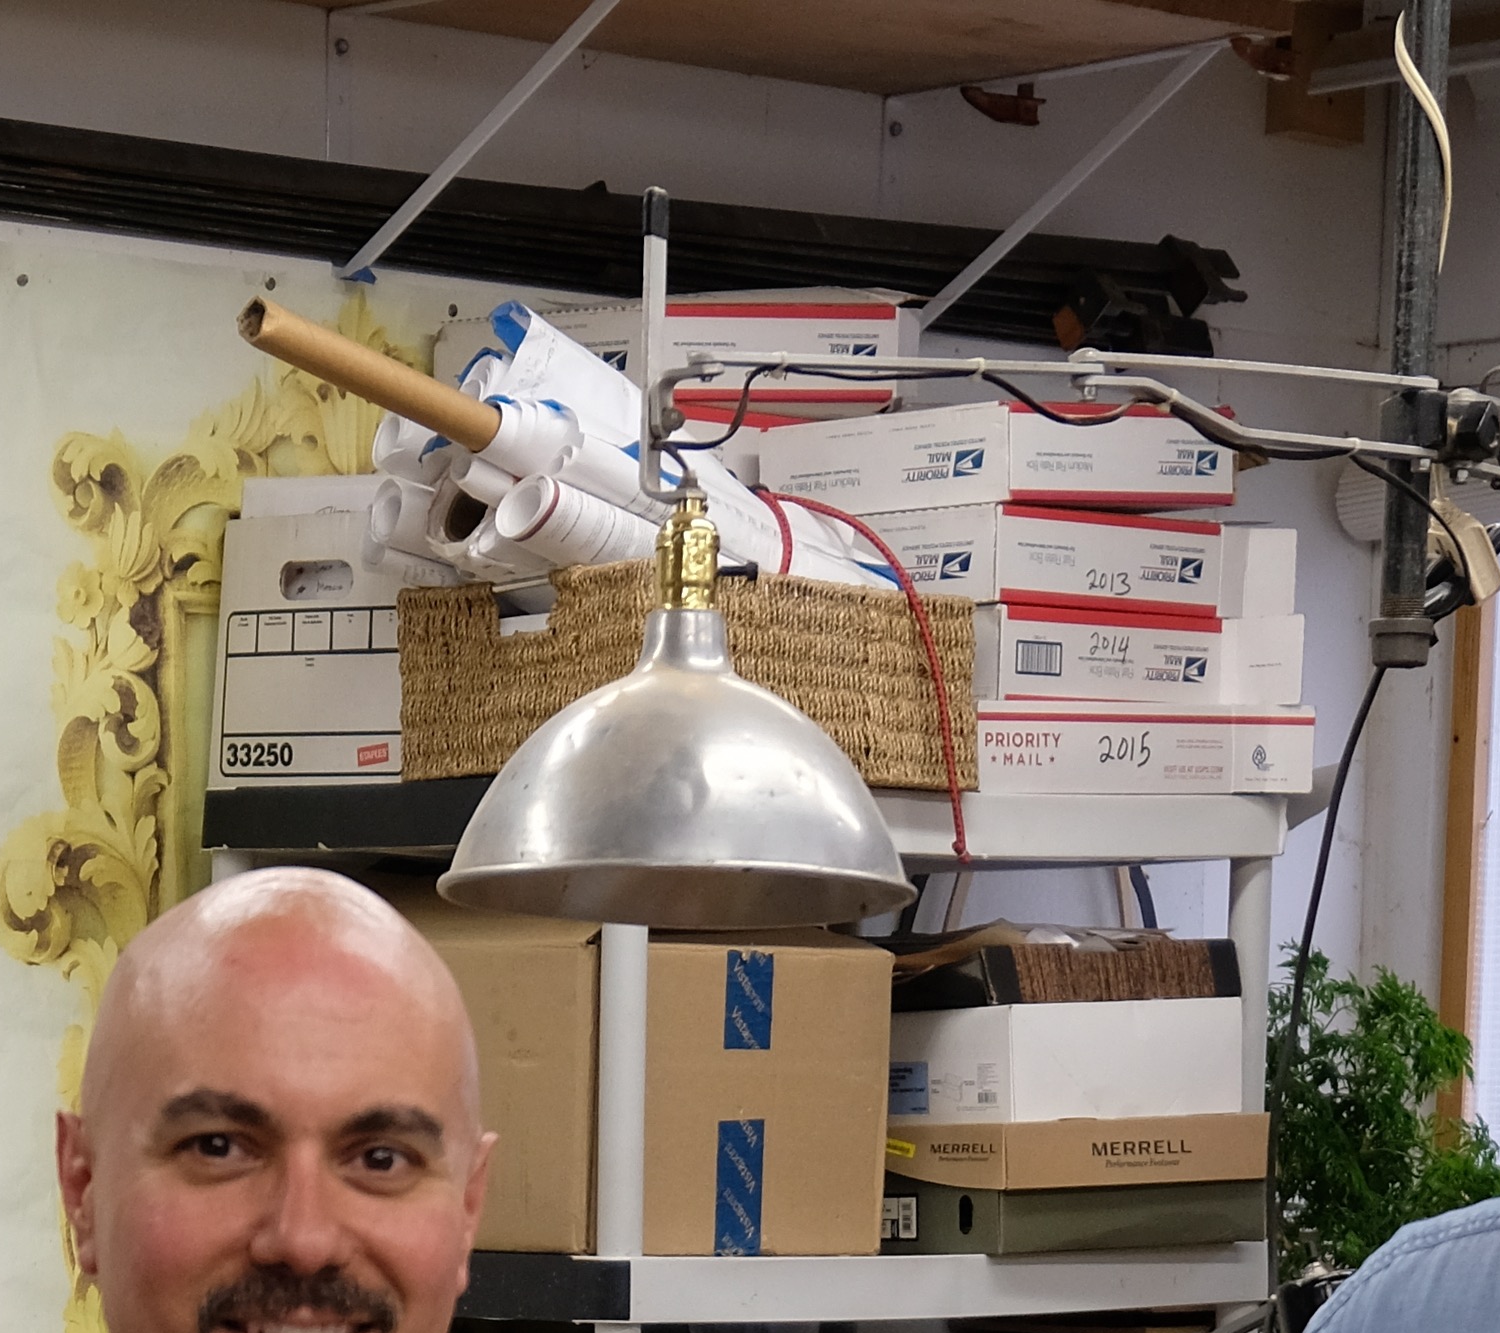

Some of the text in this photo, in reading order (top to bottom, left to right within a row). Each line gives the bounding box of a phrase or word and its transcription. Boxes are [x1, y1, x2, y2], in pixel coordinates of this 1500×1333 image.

[926, 451, 952, 463] MAIL
[1175, 449, 1195, 459] MAIL
[904, 467, 950, 483] PRIORITY
[1158, 464, 1193, 476] PRIORITY
[914, 553, 939, 567] MAIL
[1158, 554, 1179, 566] MAIL
[1086, 568, 1132, 595] 2013
[1141, 570, 1176, 583] PRIORITY
[1090, 631, 1130, 663] 2014
[1144, 669, 1181, 682] PRIORITY
[984, 732, 1062, 748] PRIORITY
[226, 742, 293, 768] 33250
[1098, 731, 1151, 767] 2015
[1003, 753, 1043, 766] MAIL
[930, 1143, 997, 1154] MERRELL
[1091, 1139, 1192, 1157] MERRELL
